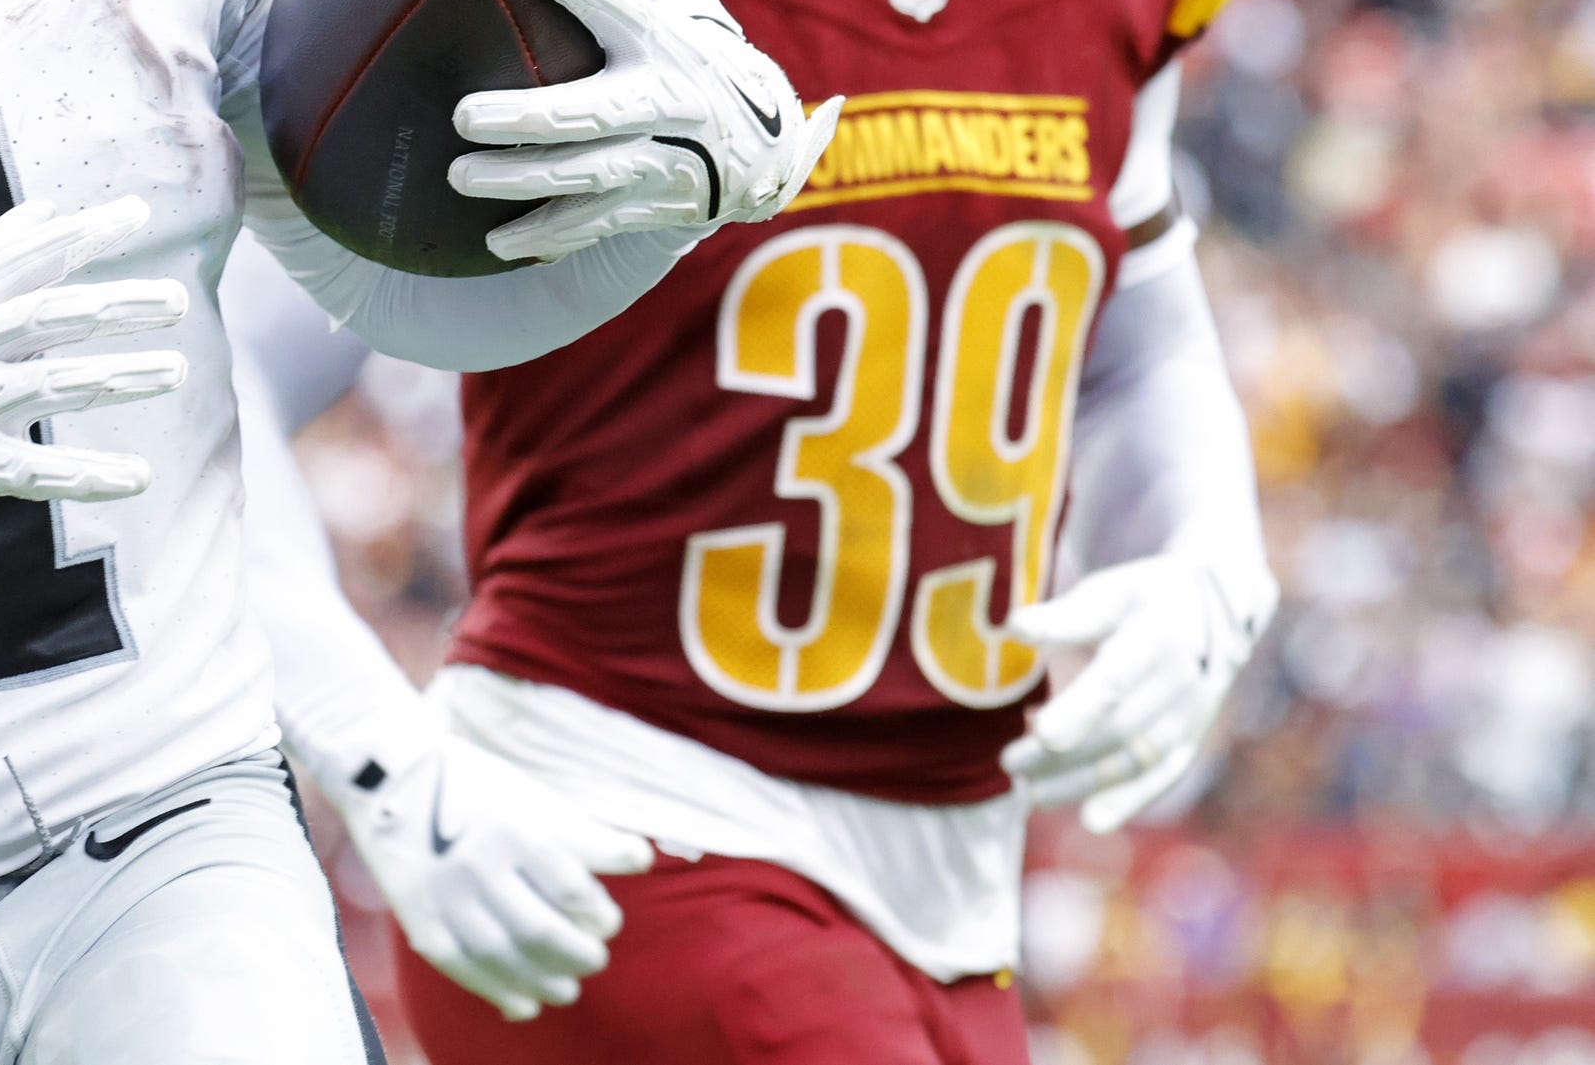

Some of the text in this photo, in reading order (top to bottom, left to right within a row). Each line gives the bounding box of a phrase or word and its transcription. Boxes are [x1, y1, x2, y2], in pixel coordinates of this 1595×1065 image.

[381, 126, 413, 208] NATIONAL
[807, 108, 1091, 189] OMMANDERS
[678, 222, 1106, 713] 39
